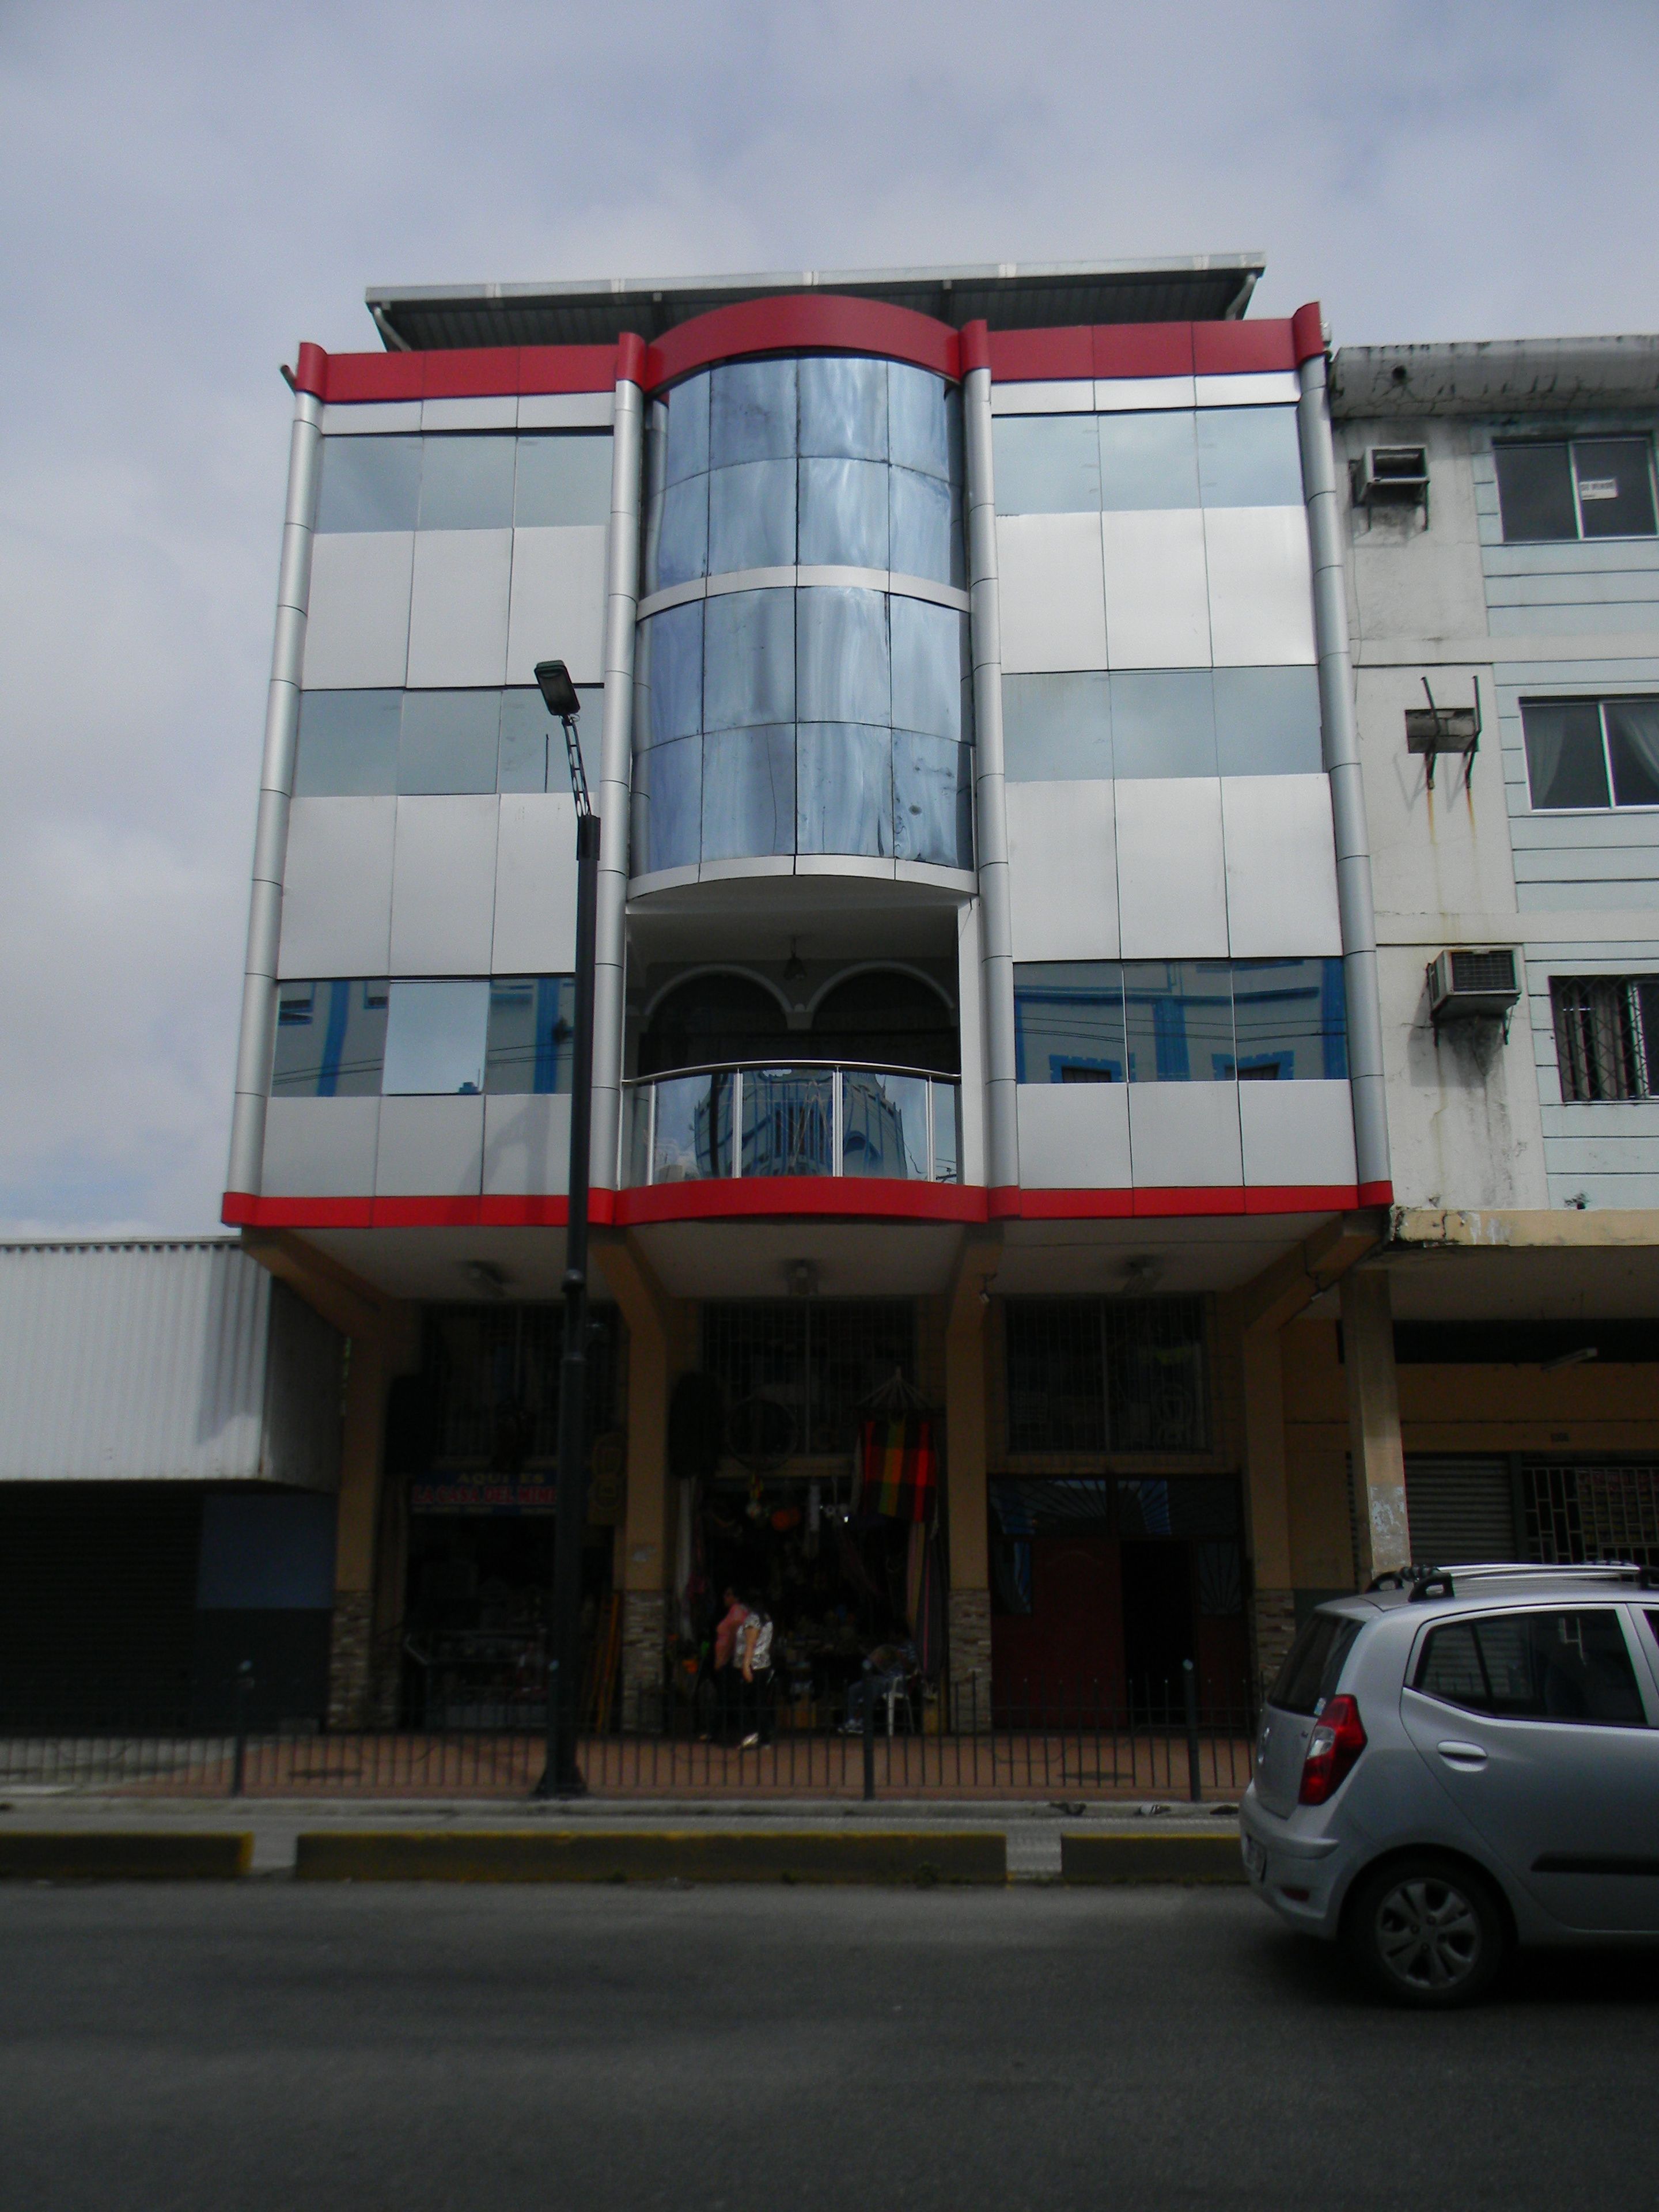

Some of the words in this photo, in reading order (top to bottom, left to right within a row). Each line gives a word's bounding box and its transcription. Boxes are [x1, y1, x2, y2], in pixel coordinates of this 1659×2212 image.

[413, 1486, 434, 1503] LA
[436, 1485, 480, 1503] CASA
[484, 1484, 514, 1503] DEL
